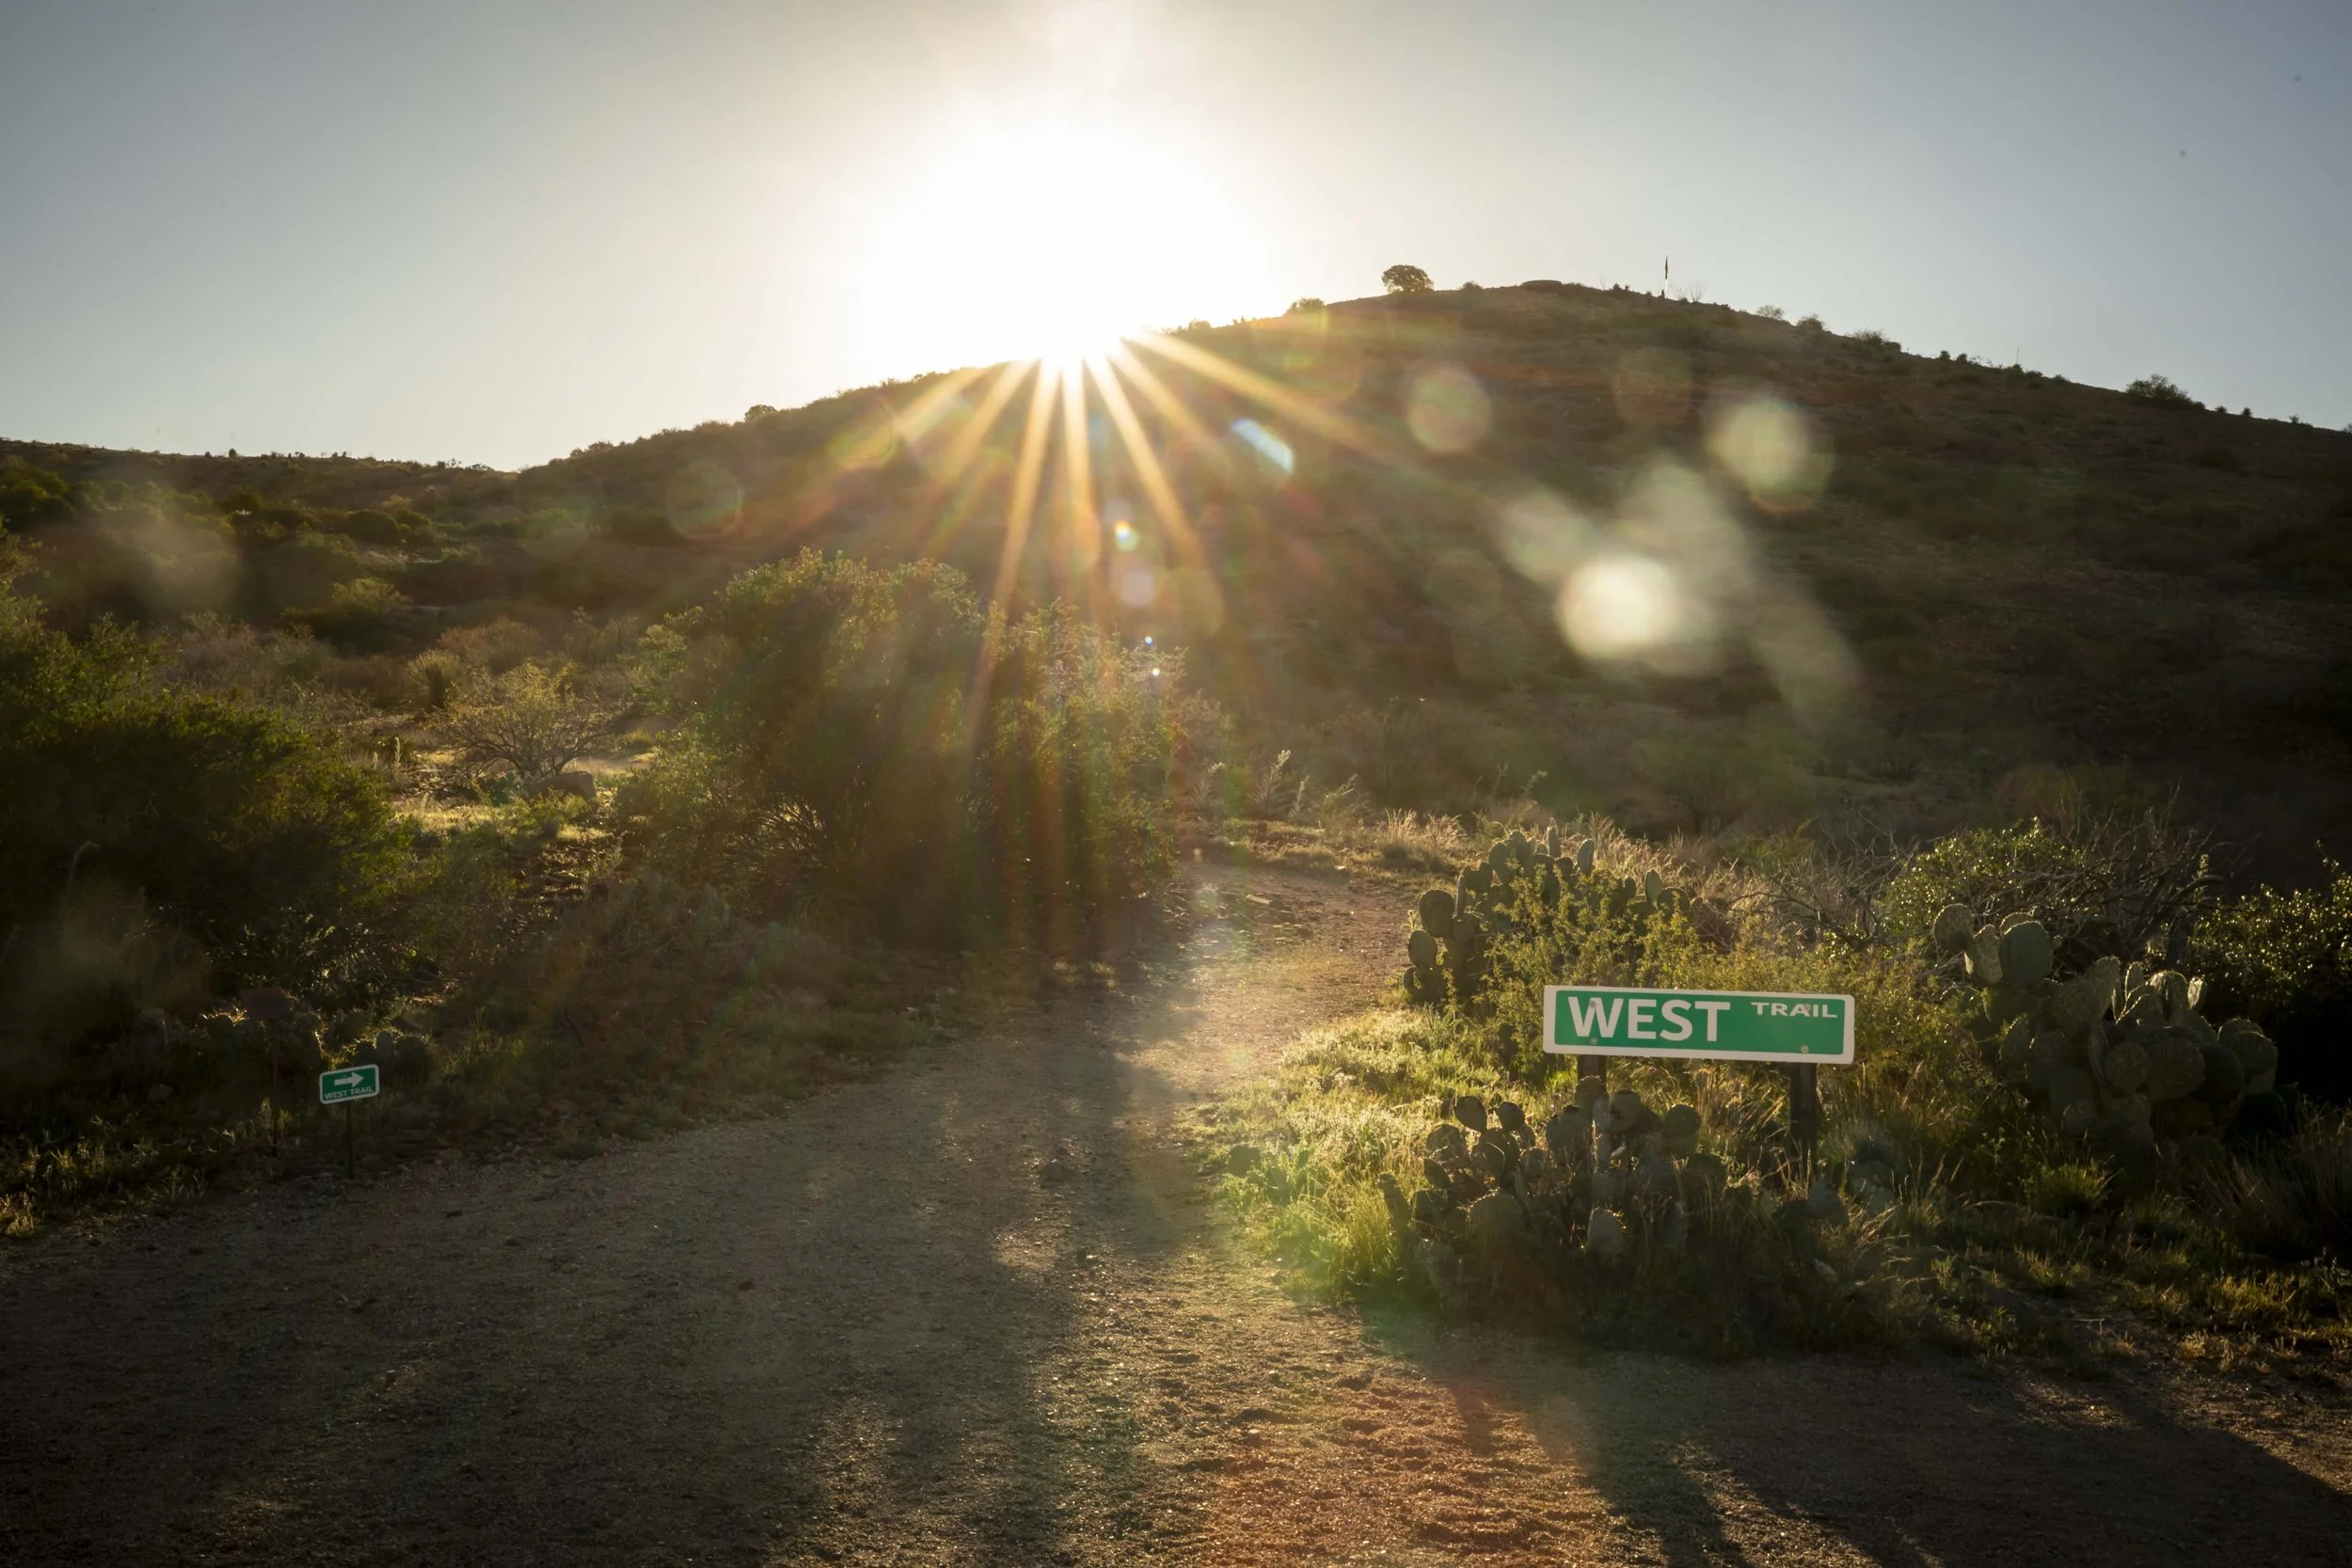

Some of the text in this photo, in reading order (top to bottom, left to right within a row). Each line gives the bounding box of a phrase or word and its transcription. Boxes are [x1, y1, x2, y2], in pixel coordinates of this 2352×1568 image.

[1567, 996, 1837, 1041] WEST TRAIL
[325, 1086, 373, 1100] WEST TRAIL
